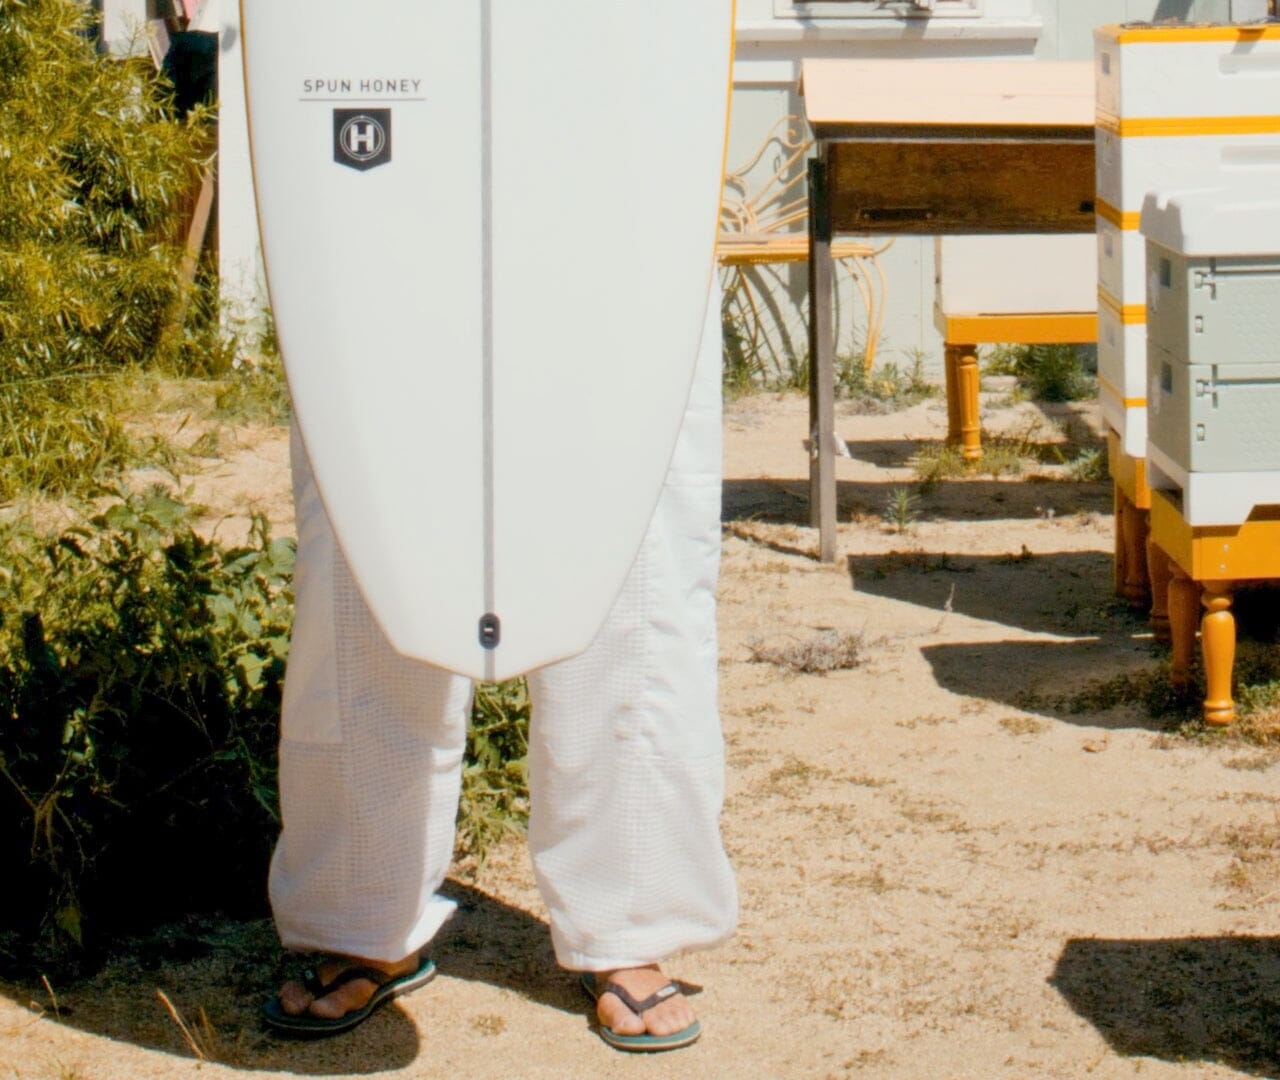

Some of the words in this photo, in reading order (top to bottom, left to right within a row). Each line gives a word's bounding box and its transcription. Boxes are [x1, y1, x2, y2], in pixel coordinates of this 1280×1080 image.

[303, 79, 352, 93] SPUN
[360, 79, 421, 93] HONEY
[350, 124, 374, 152] H
